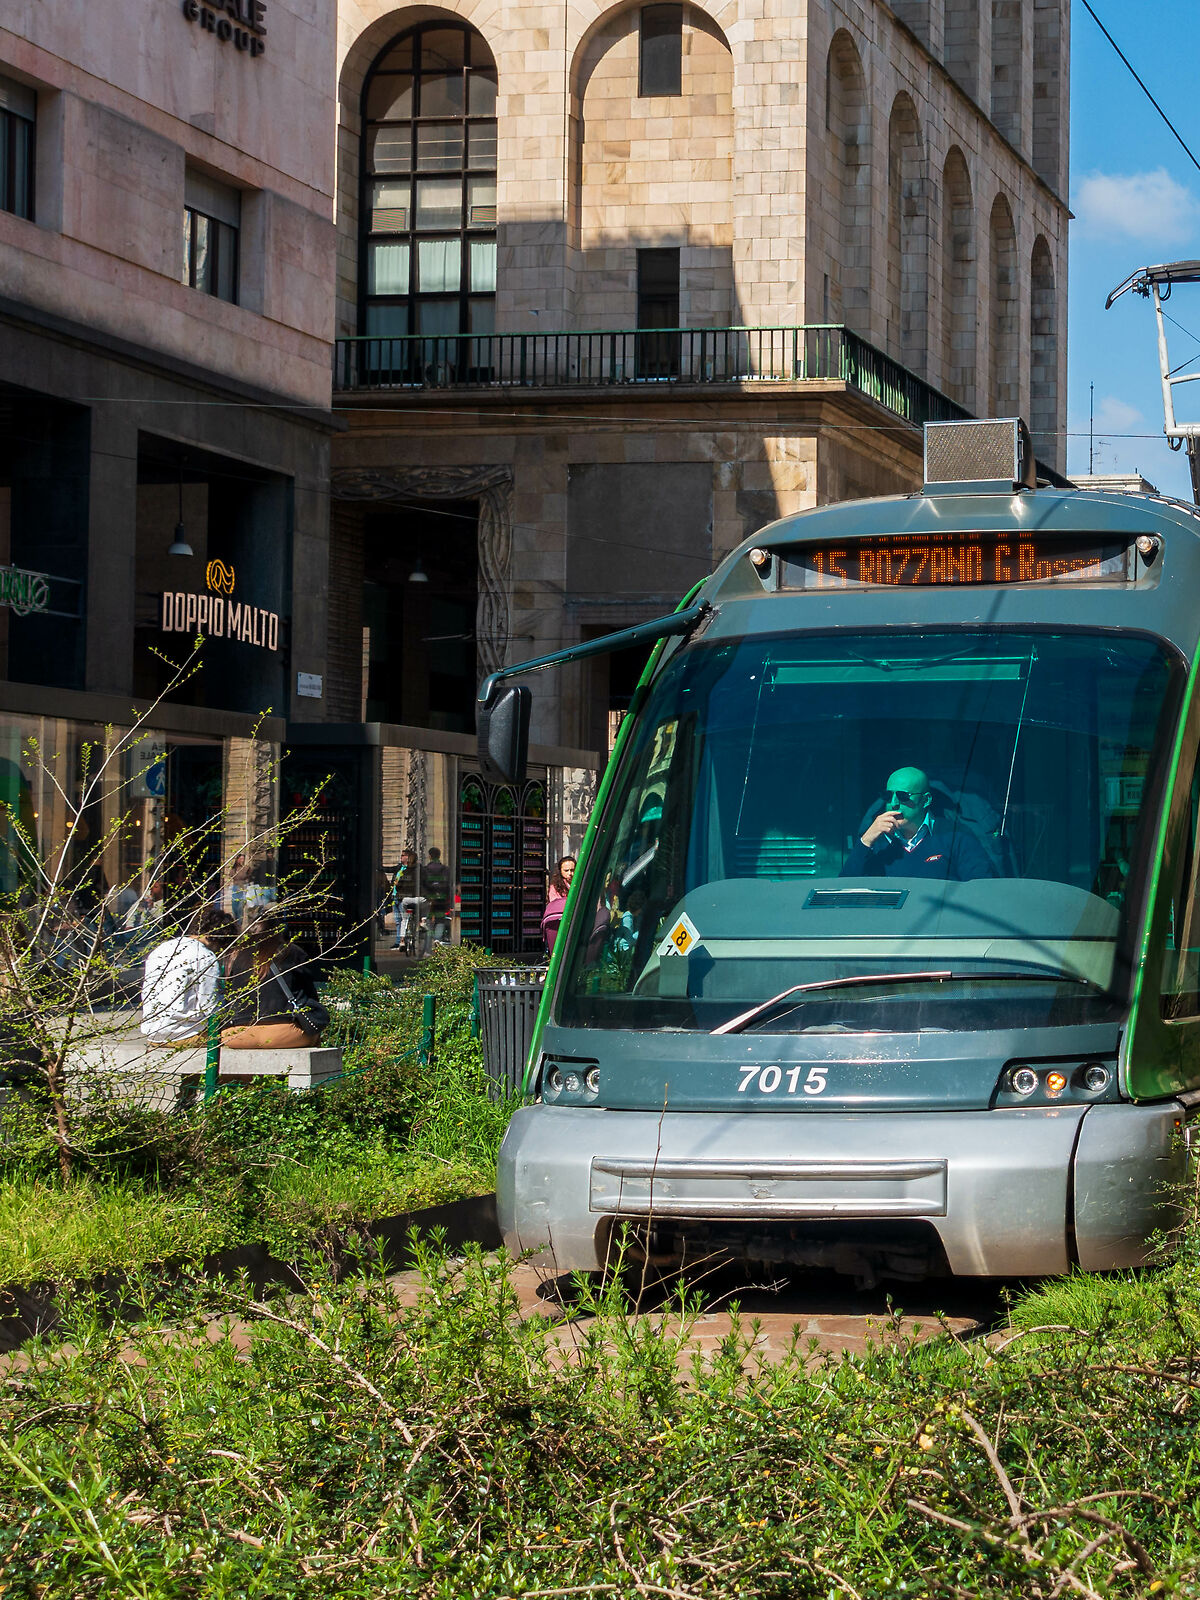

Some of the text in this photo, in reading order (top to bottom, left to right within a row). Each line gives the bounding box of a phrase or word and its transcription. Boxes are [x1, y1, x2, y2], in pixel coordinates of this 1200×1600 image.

[183, 0, 265, 57] GROUP
[201, 0, 266, 35] ALE
[812, 551, 847, 587] 15
[1019, 544, 1100, 580] Rossa
[162, 592, 278, 651] DOPPIO MALTO
[676, 930, 687, 946] 8
[738, 1065, 829, 1095] 7015
